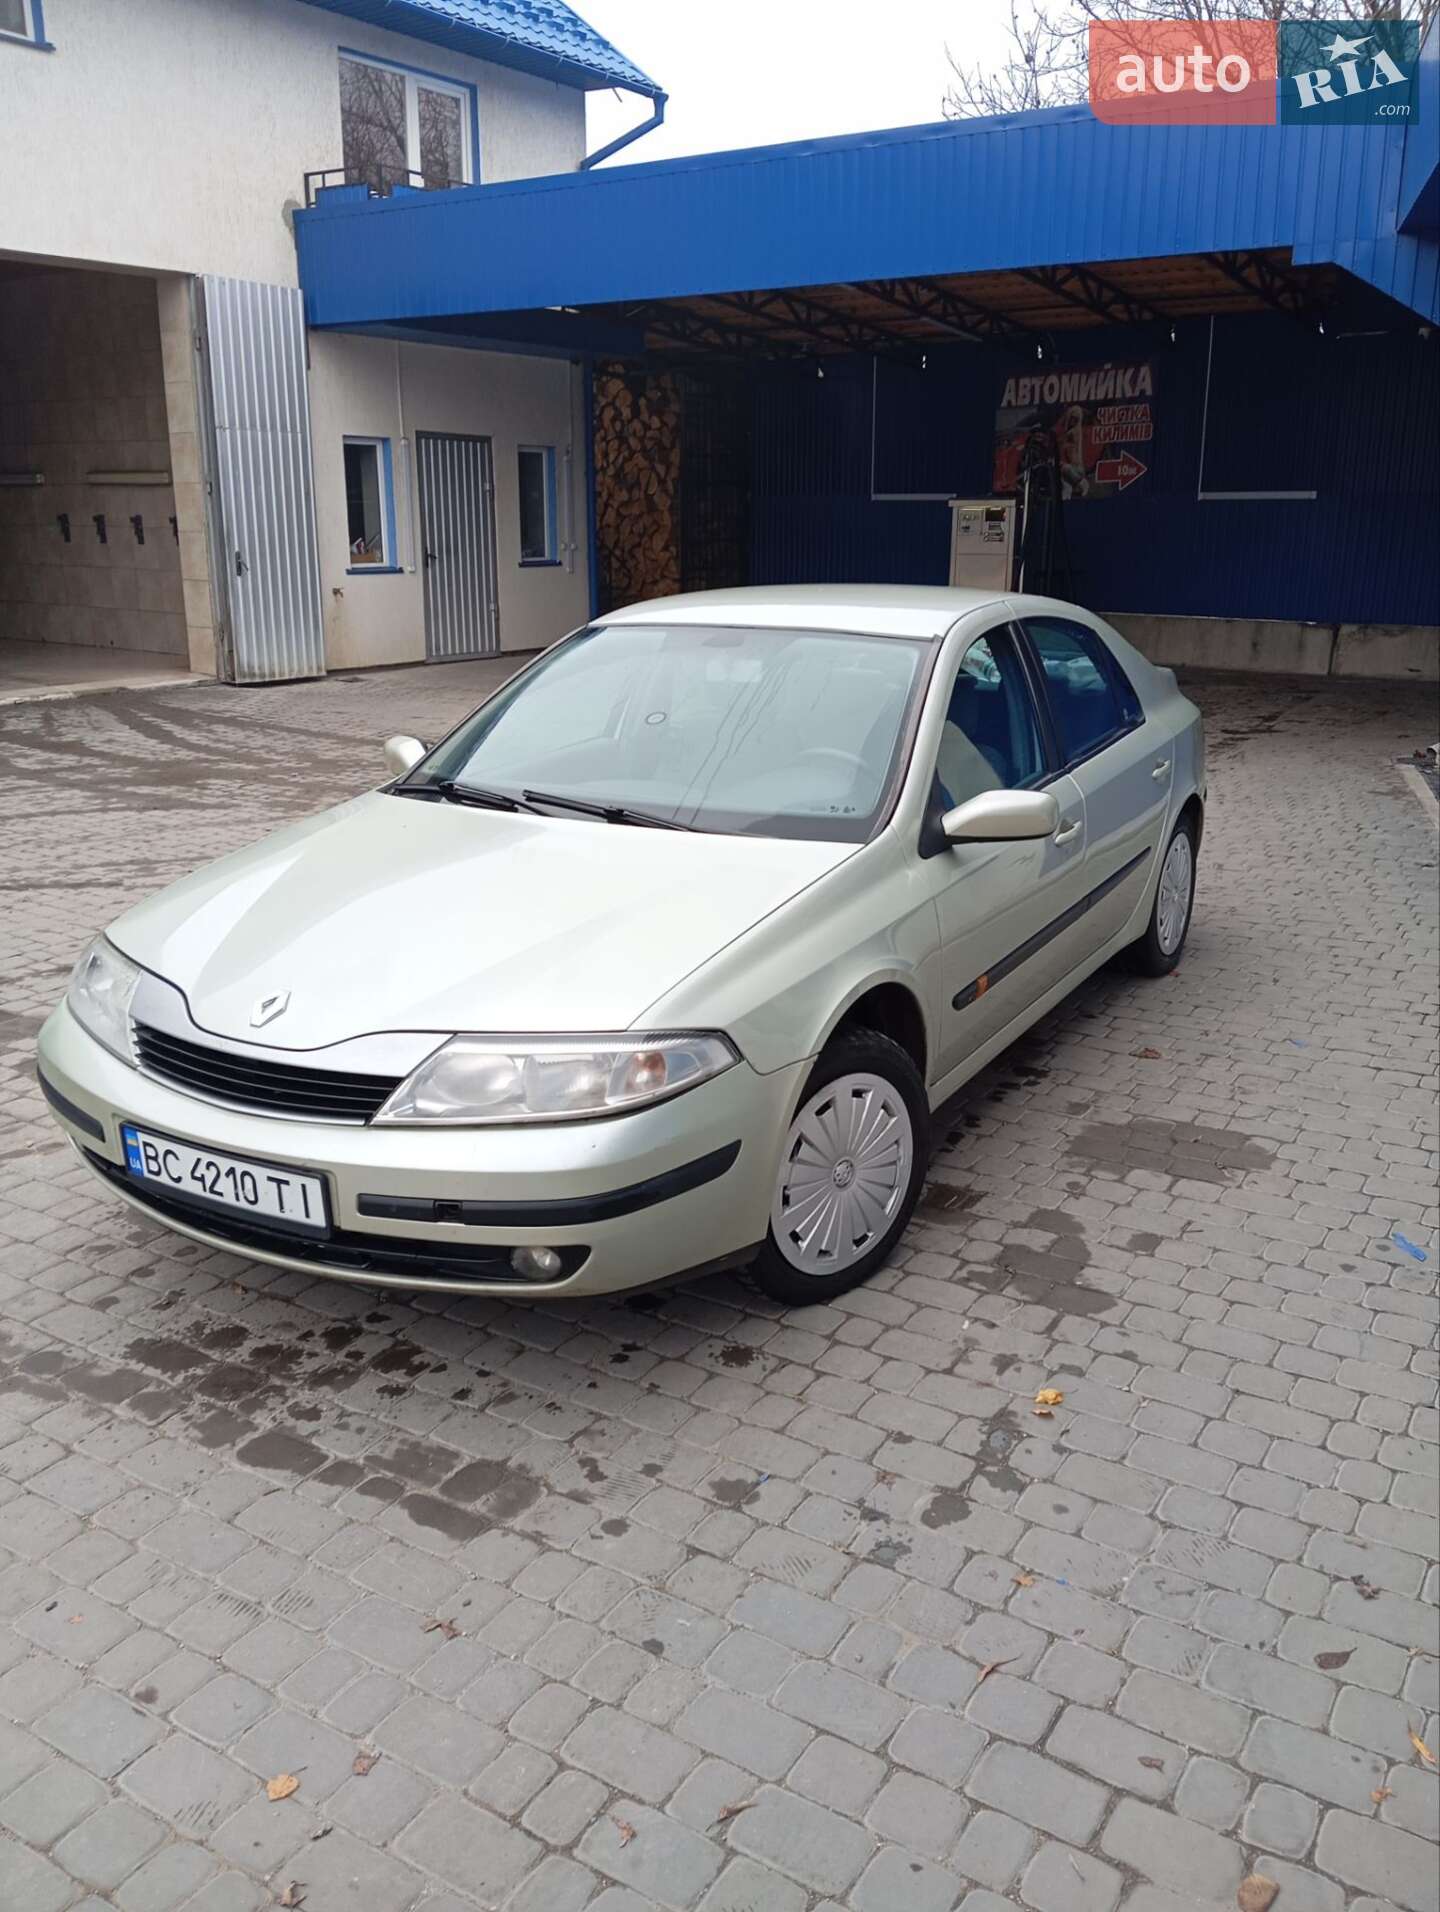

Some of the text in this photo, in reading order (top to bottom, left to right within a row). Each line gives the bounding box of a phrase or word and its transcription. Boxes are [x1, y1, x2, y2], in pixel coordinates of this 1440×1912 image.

[1000, 363, 1153, 408] АВТОМИЙКА
[1096, 404, 1151, 425] ЧИСТКА
[1093, 423, 1153, 443] КИЛИМІВ
[129, 1157, 142, 1170] UA
[142, 1141, 311, 1219] BC 4210 TI
